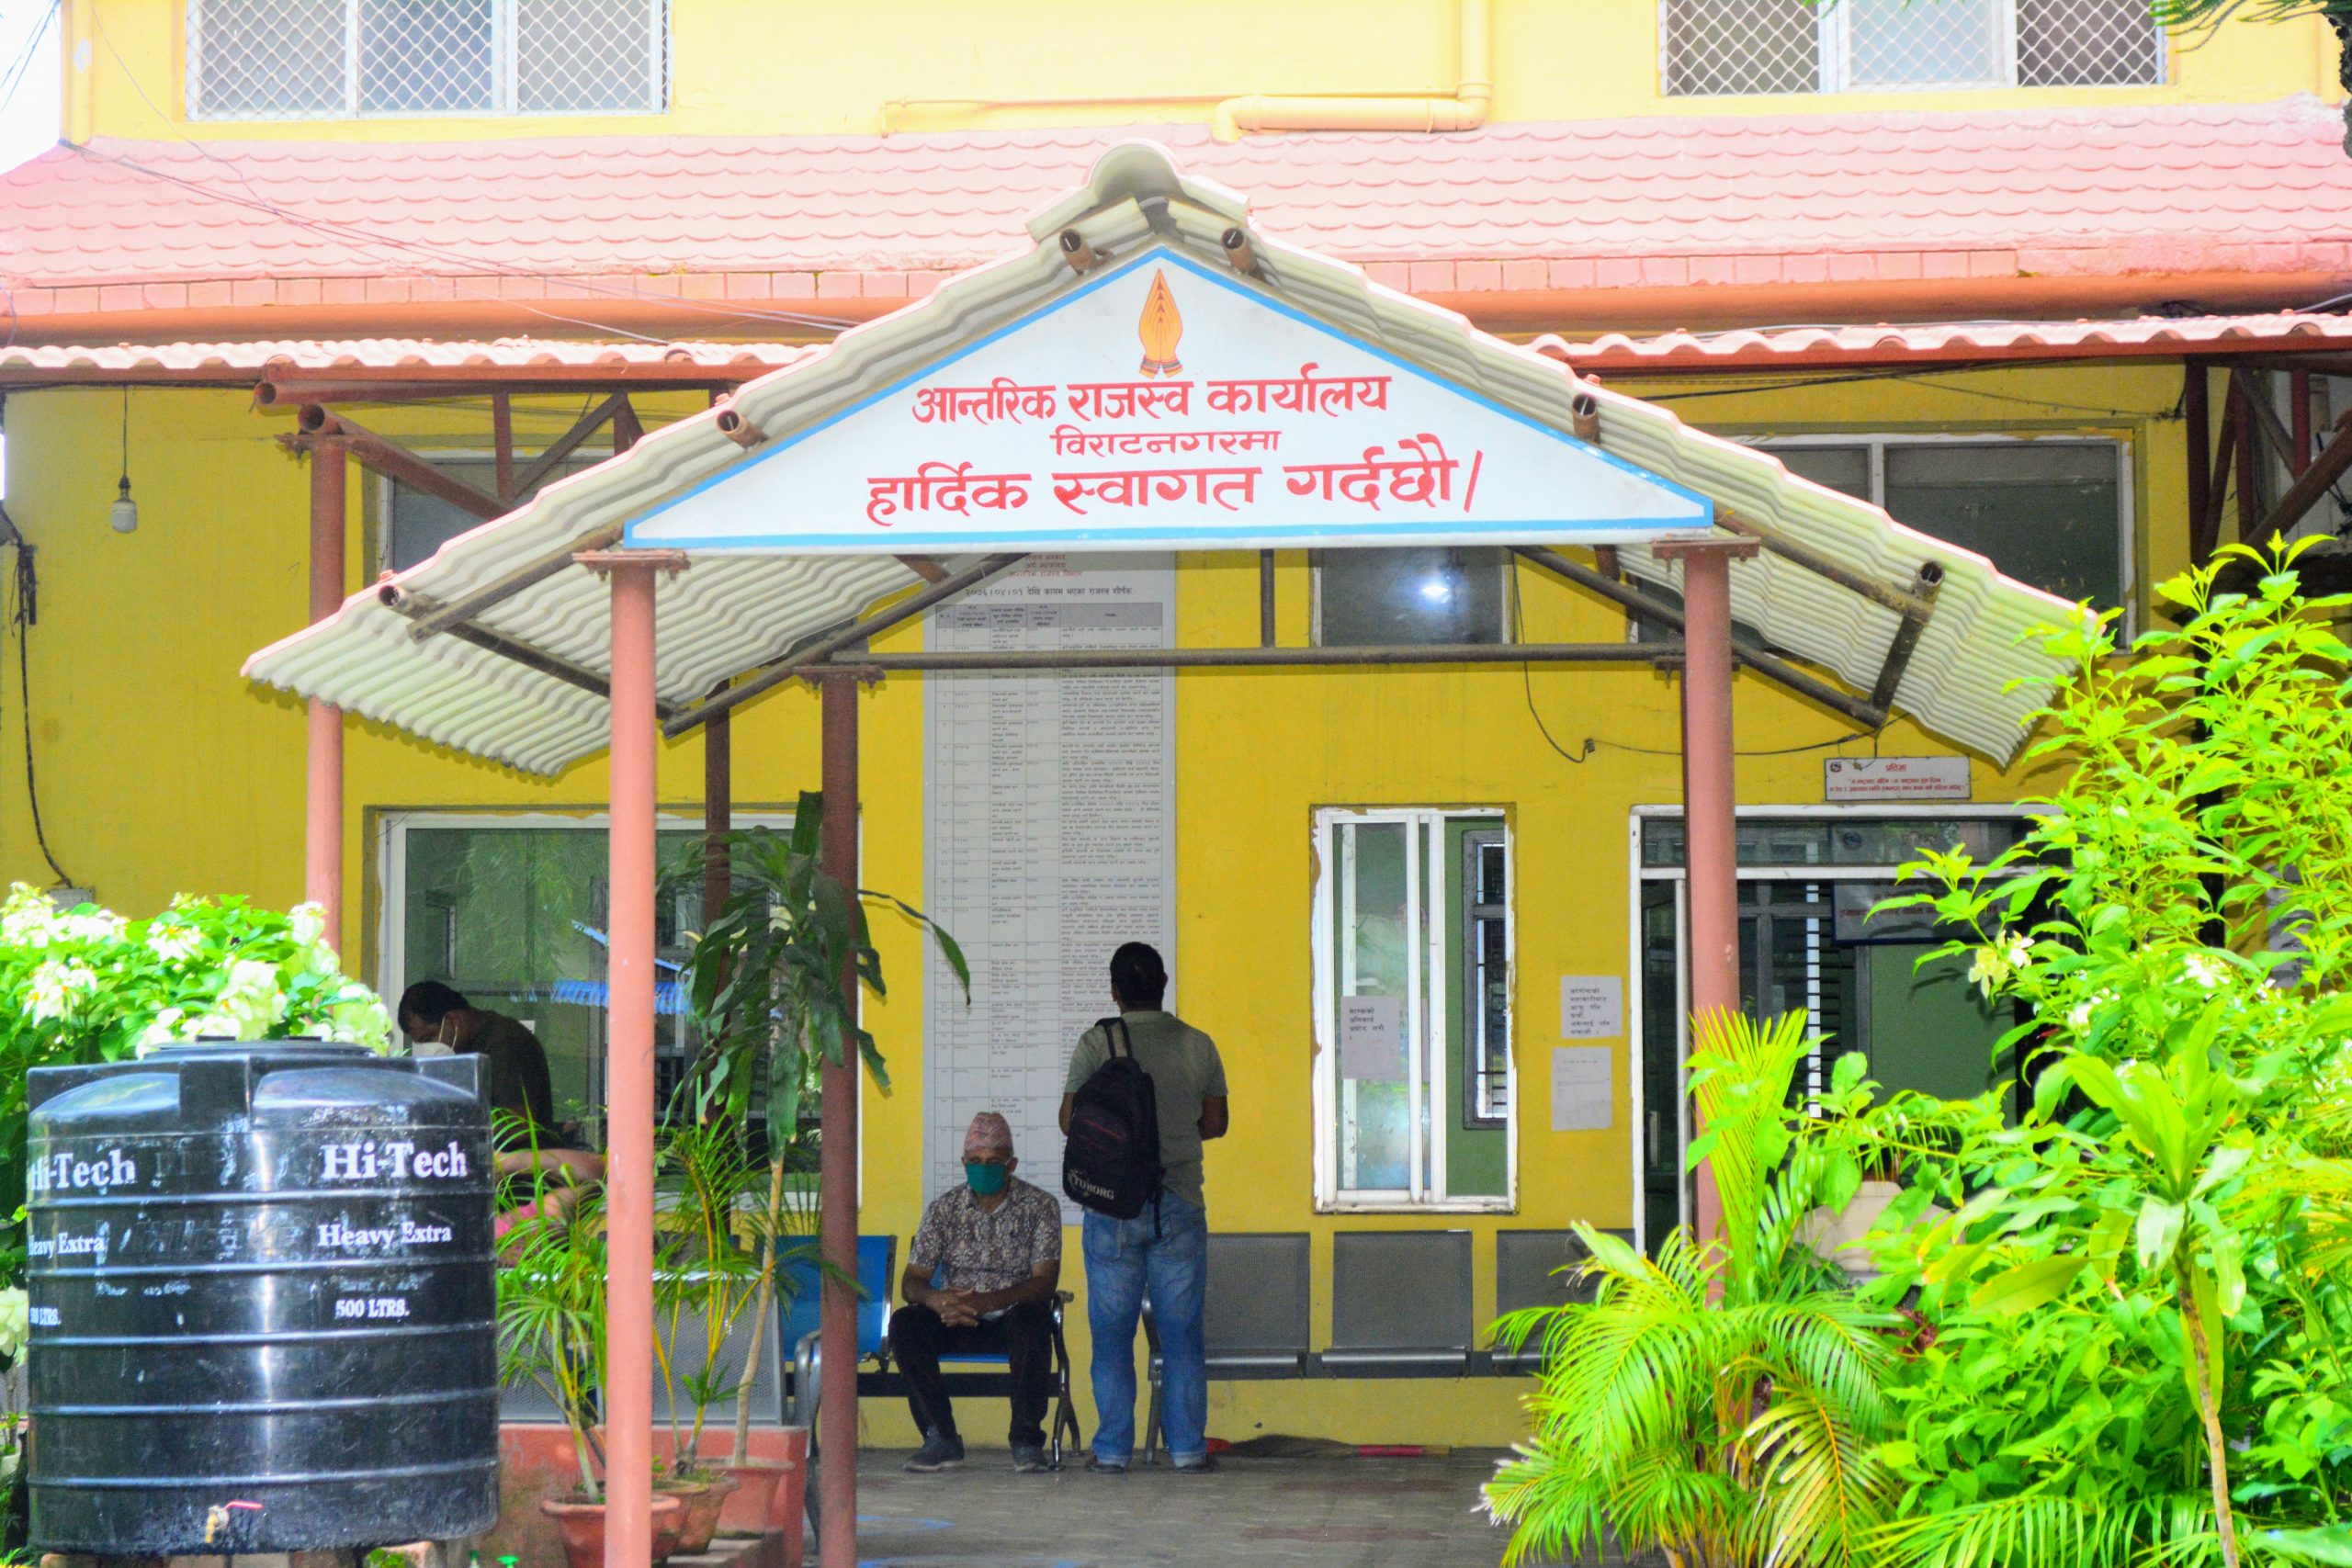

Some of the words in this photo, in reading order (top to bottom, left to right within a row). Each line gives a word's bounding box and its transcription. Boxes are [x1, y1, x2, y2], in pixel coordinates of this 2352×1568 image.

[912, 377, 1056, 424] आन्तरिक
[1067, 381, 1194, 422] राजस्व
[1206, 362, 1392, 417] कार्यालय
[1049, 424, 1282, 457] विराटनगरमा
[866, 462, 1032, 526] हार्दिक
[1051, 467, 1262, 515] स्वागत
[30, 1148, 137, 1190] Hi-Tech
[321, 1140, 468, 1179] Hi-Tech
[1074, 1176, 1114, 1201] TUBORG
[28, 1235, 55, 1259] Heavy
[57, 1232, 106, 1255] Extra
[317, 1224, 395, 1250] Heavy
[401, 1221, 452, 1244] Extra
[335, 1298, 365, 1318] 500
